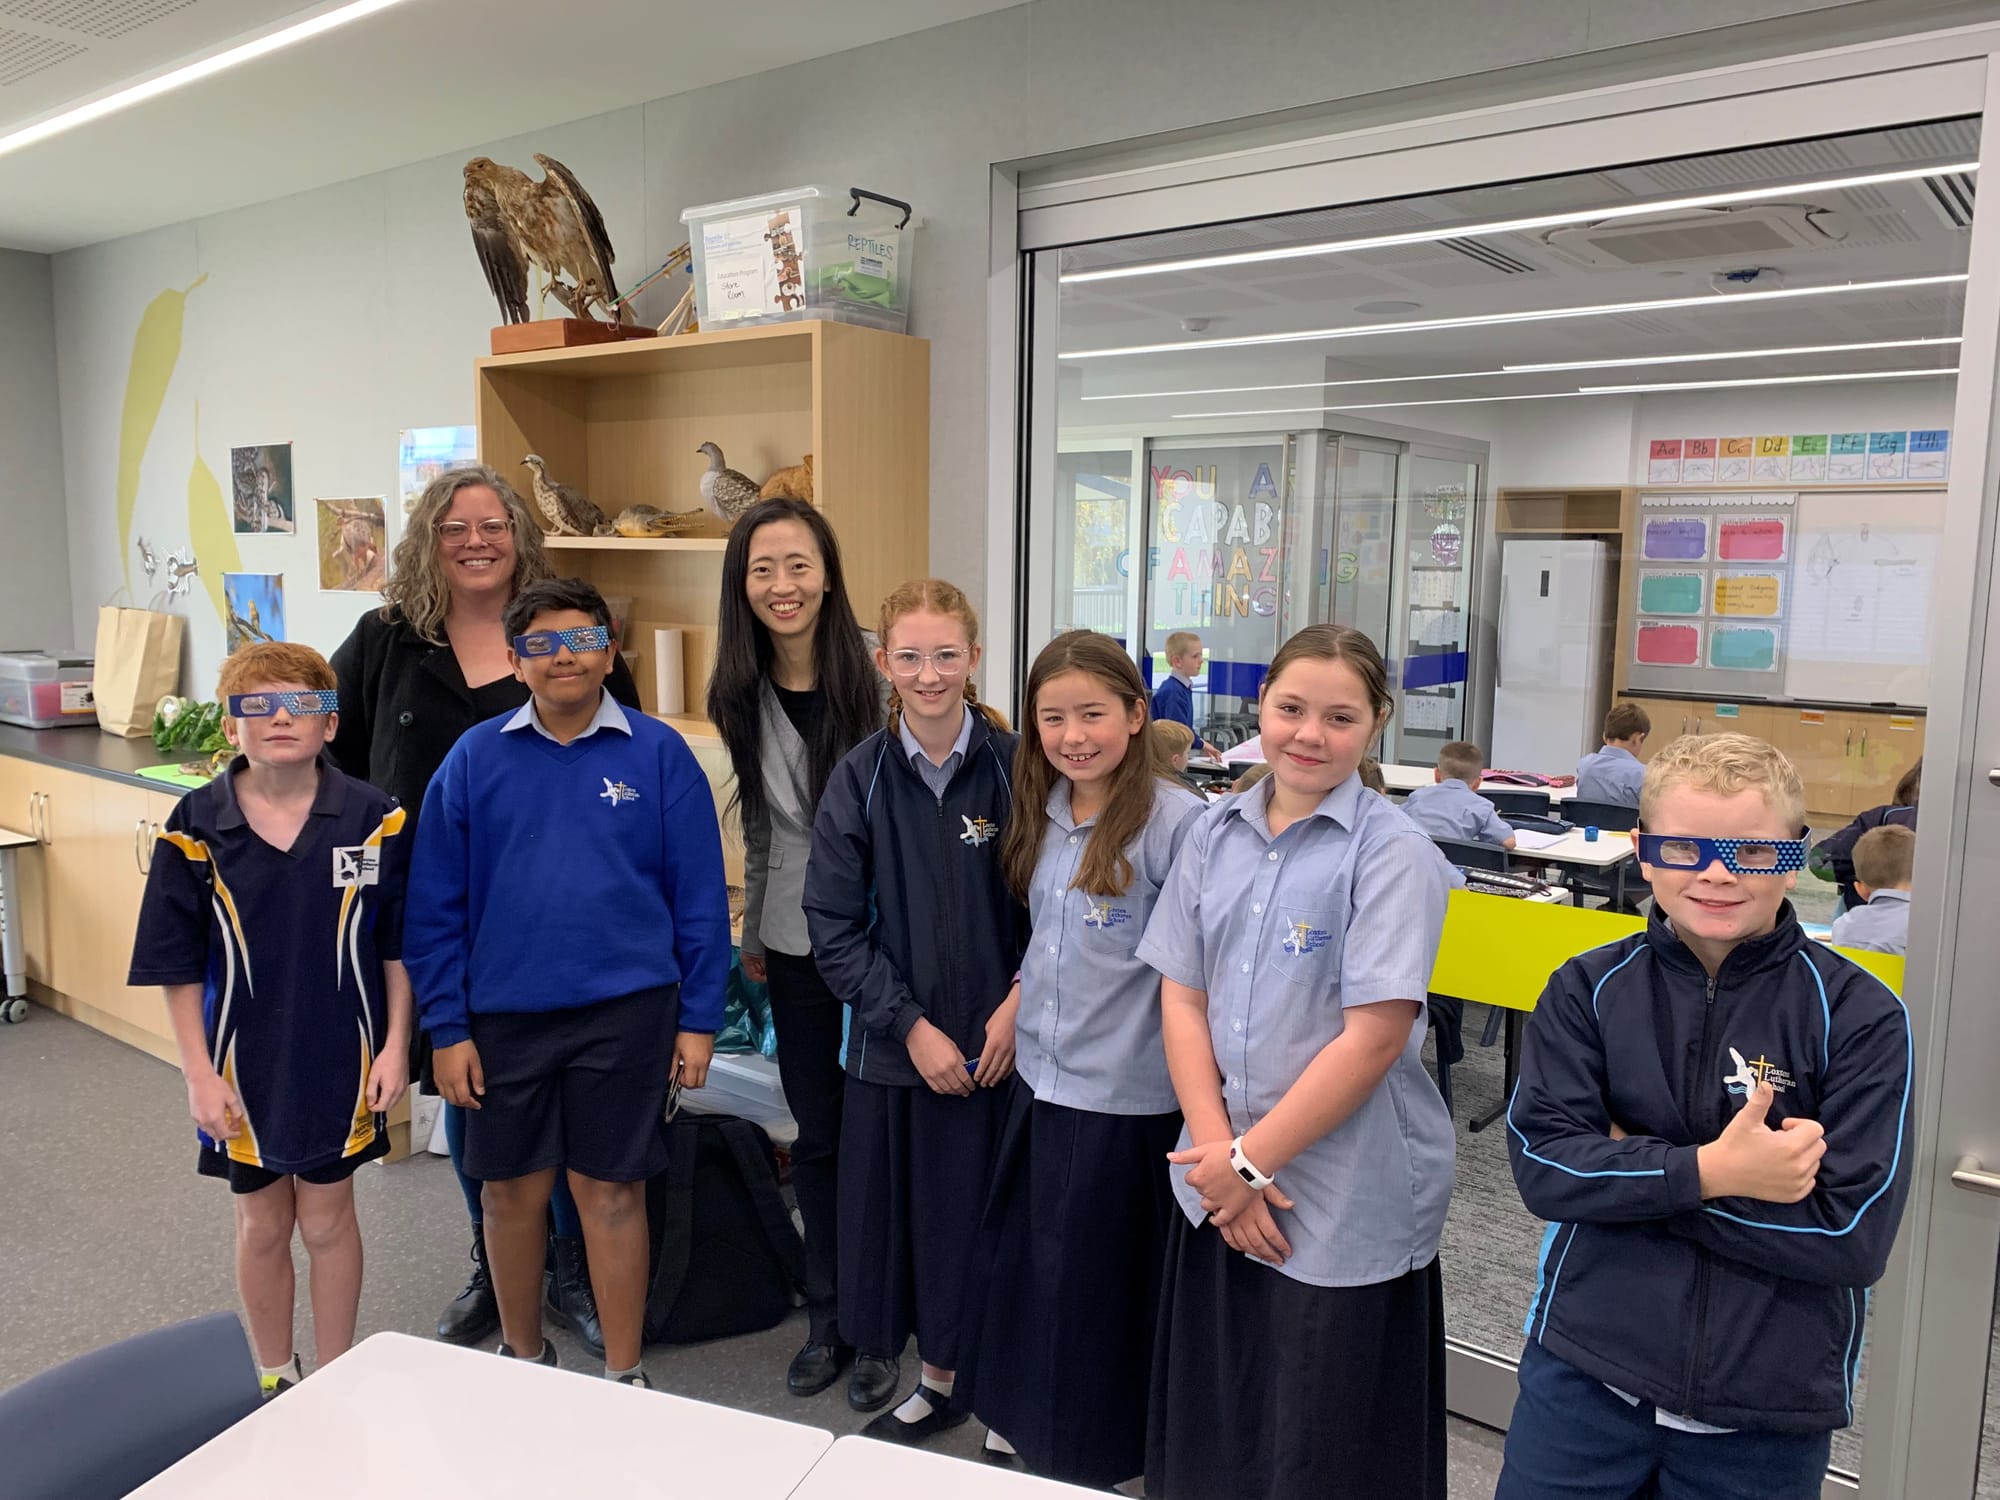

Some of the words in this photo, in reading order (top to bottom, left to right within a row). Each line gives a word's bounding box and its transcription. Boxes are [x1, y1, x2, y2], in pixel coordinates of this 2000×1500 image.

[848, 233, 893, 261] REPTILES
[1692, 441, 1708, 455] Bb
[1762, 438, 1783, 453] Dd
[1840, 435, 1859, 451] Ff
[1917, 432, 1939, 448] Hh
[1656, 442, 1675, 456] Aa
[1151, 464, 1217, 500] YOU
[1161, 501, 1283, 546] CAPAB
[1173, 582, 1291, 622] THING
[1764, 1073, 1797, 1088] Lutheran
[1765, 1066, 1791, 1079] Loxton
